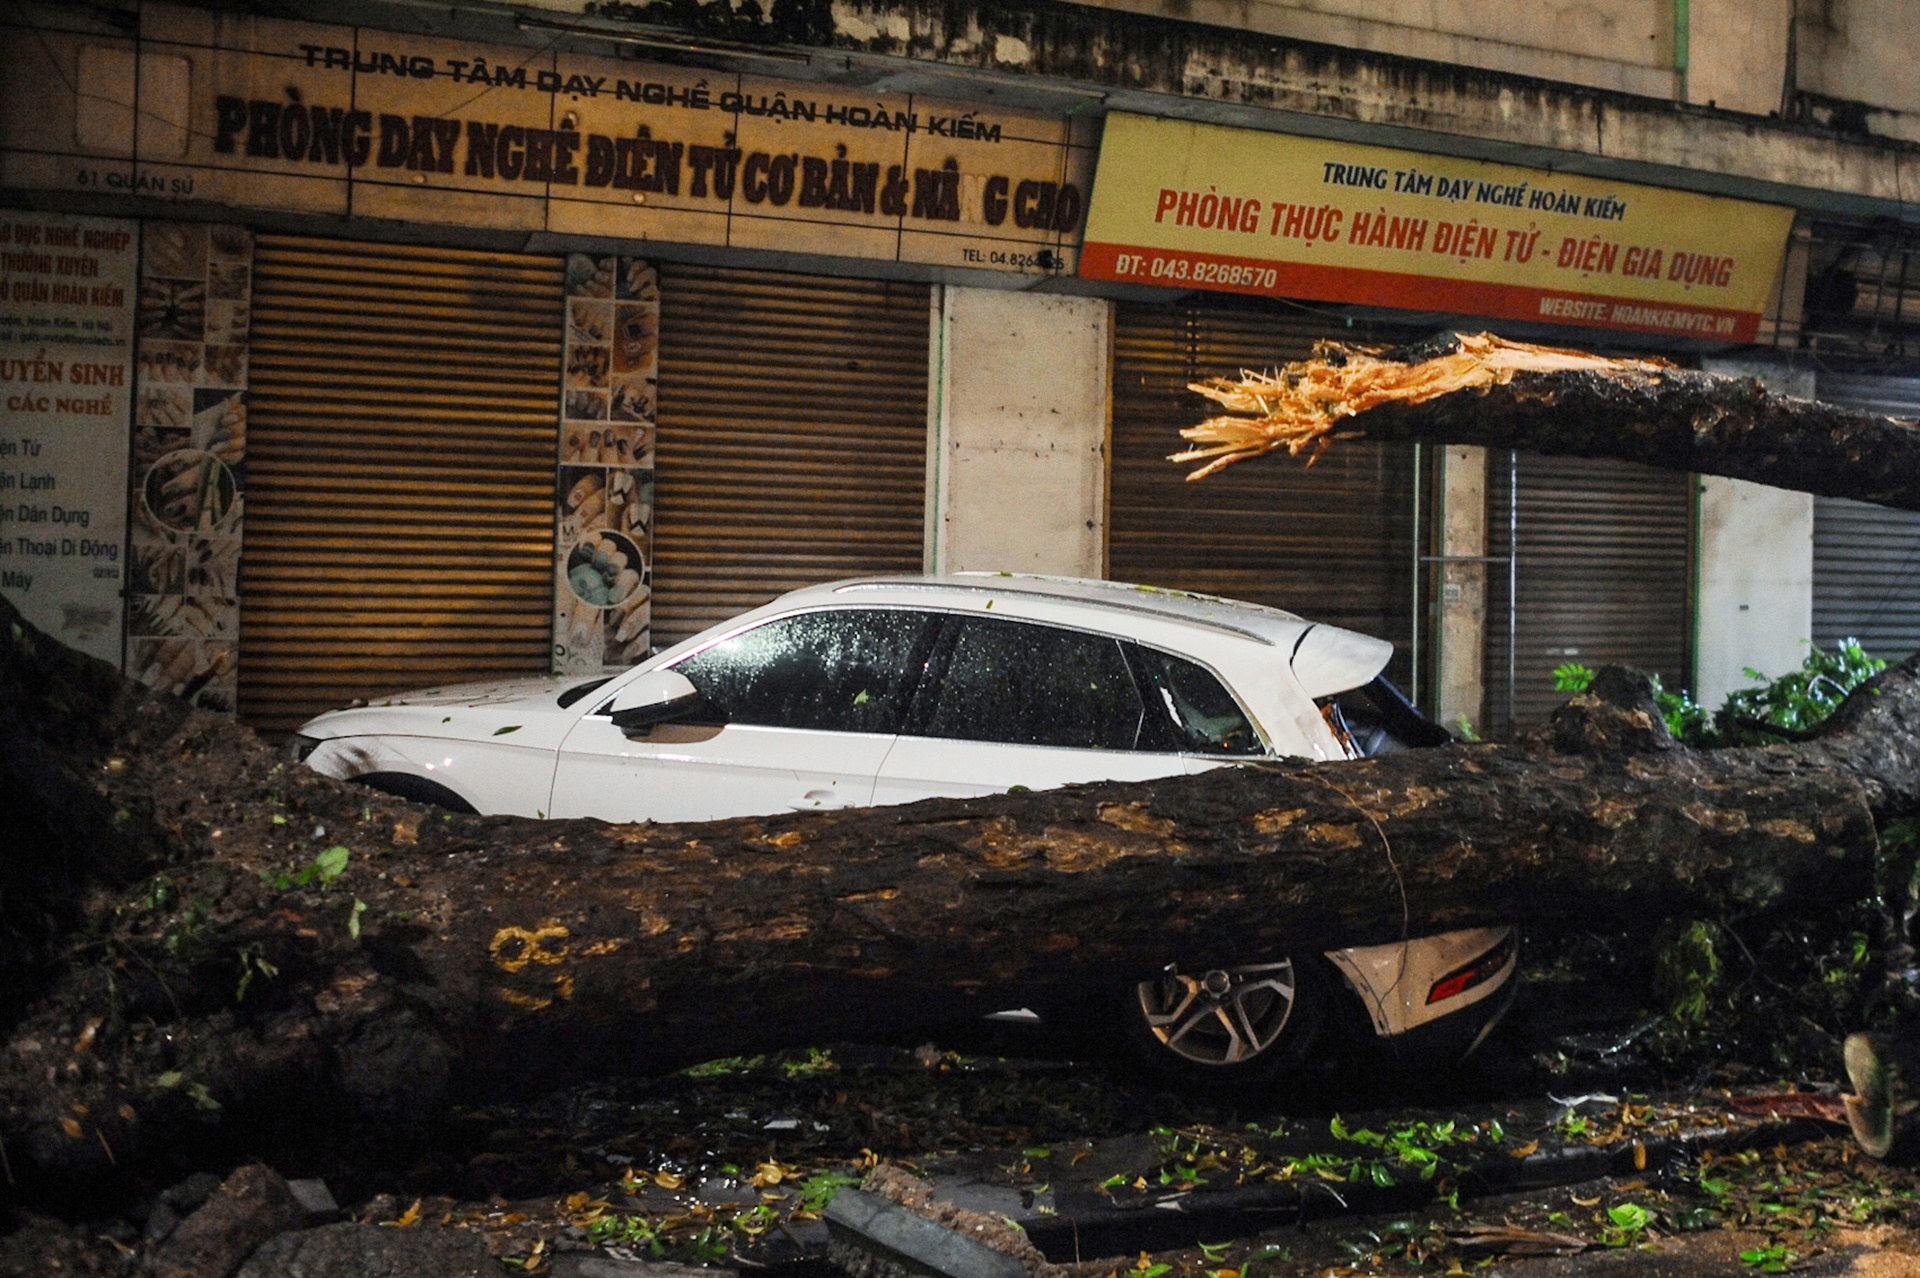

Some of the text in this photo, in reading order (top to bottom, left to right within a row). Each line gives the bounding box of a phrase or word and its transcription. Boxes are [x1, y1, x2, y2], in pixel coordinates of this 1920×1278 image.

[300, 44, 1001, 143] TRUNG TÂM DẠY NGHỀ QUẬN HOÀN KIẾM
[214, 86, 373, 168] PHÒNG
[743, 152, 798, 206] CƠ
[797, 142, 879, 214] BẢN
[881, 164, 909, 217] &
[1013, 178, 1082, 234] CAO
[77, 168, 98, 186] 61
[1322, 161, 1626, 221] TRUNG TÂM DẠY NGHỀ HOÀN KIẾM
[1154, 185, 1263, 235] PHÒNG
[1269, 201, 1344, 248] THỰC
[1348, 207, 1429, 252] HÀNH
[1432, 217, 1499, 264] ĐIỆN
[1504, 221, 1541, 264] TỬ
[1556, 235, 1623, 278] ĐIỆN
[1622, 245, 1662, 280] GIA
[1667, 251, 1735, 290] DỤNG
[962, 248, 986, 263] TEL:
[1115, 253, 1278, 288] ĐT: 043.8268570
[1538, 297, 1737, 335] WEBSITE: HOANKIEMVTC.VN
[69, 362, 125, 387] SINH
[7, 393, 113, 415] CÁC NGHỀ
[52, 505, 90, 528] Dụng
[17, 537, 57, 558] Thoại
[61, 538, 76, 556] Di
[80, 539, 118, 560] Động
